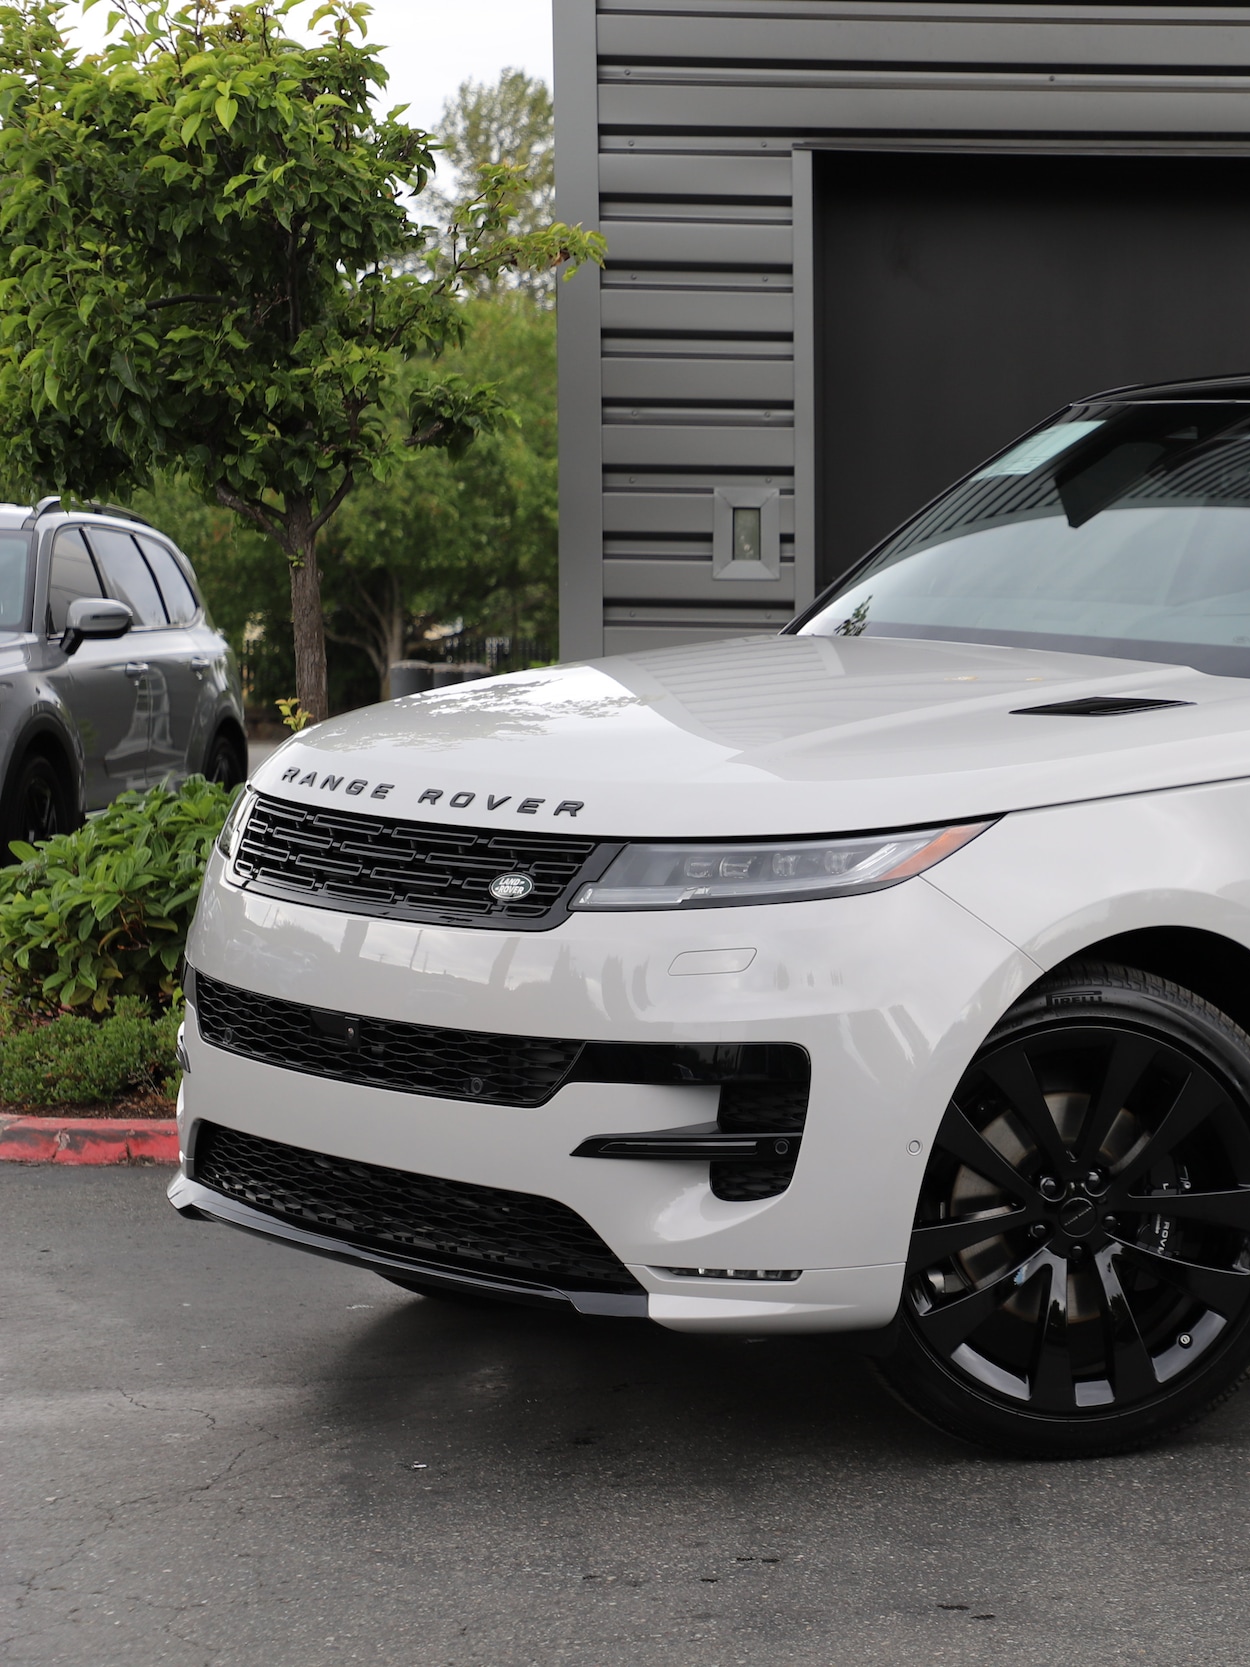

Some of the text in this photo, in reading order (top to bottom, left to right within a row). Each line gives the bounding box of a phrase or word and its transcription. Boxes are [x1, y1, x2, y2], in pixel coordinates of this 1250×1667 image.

[281, 766, 585, 817] RANGE ROVER
[498, 885, 525, 894] ROVER
[1046, 990, 1102, 1007] PIRELLI
